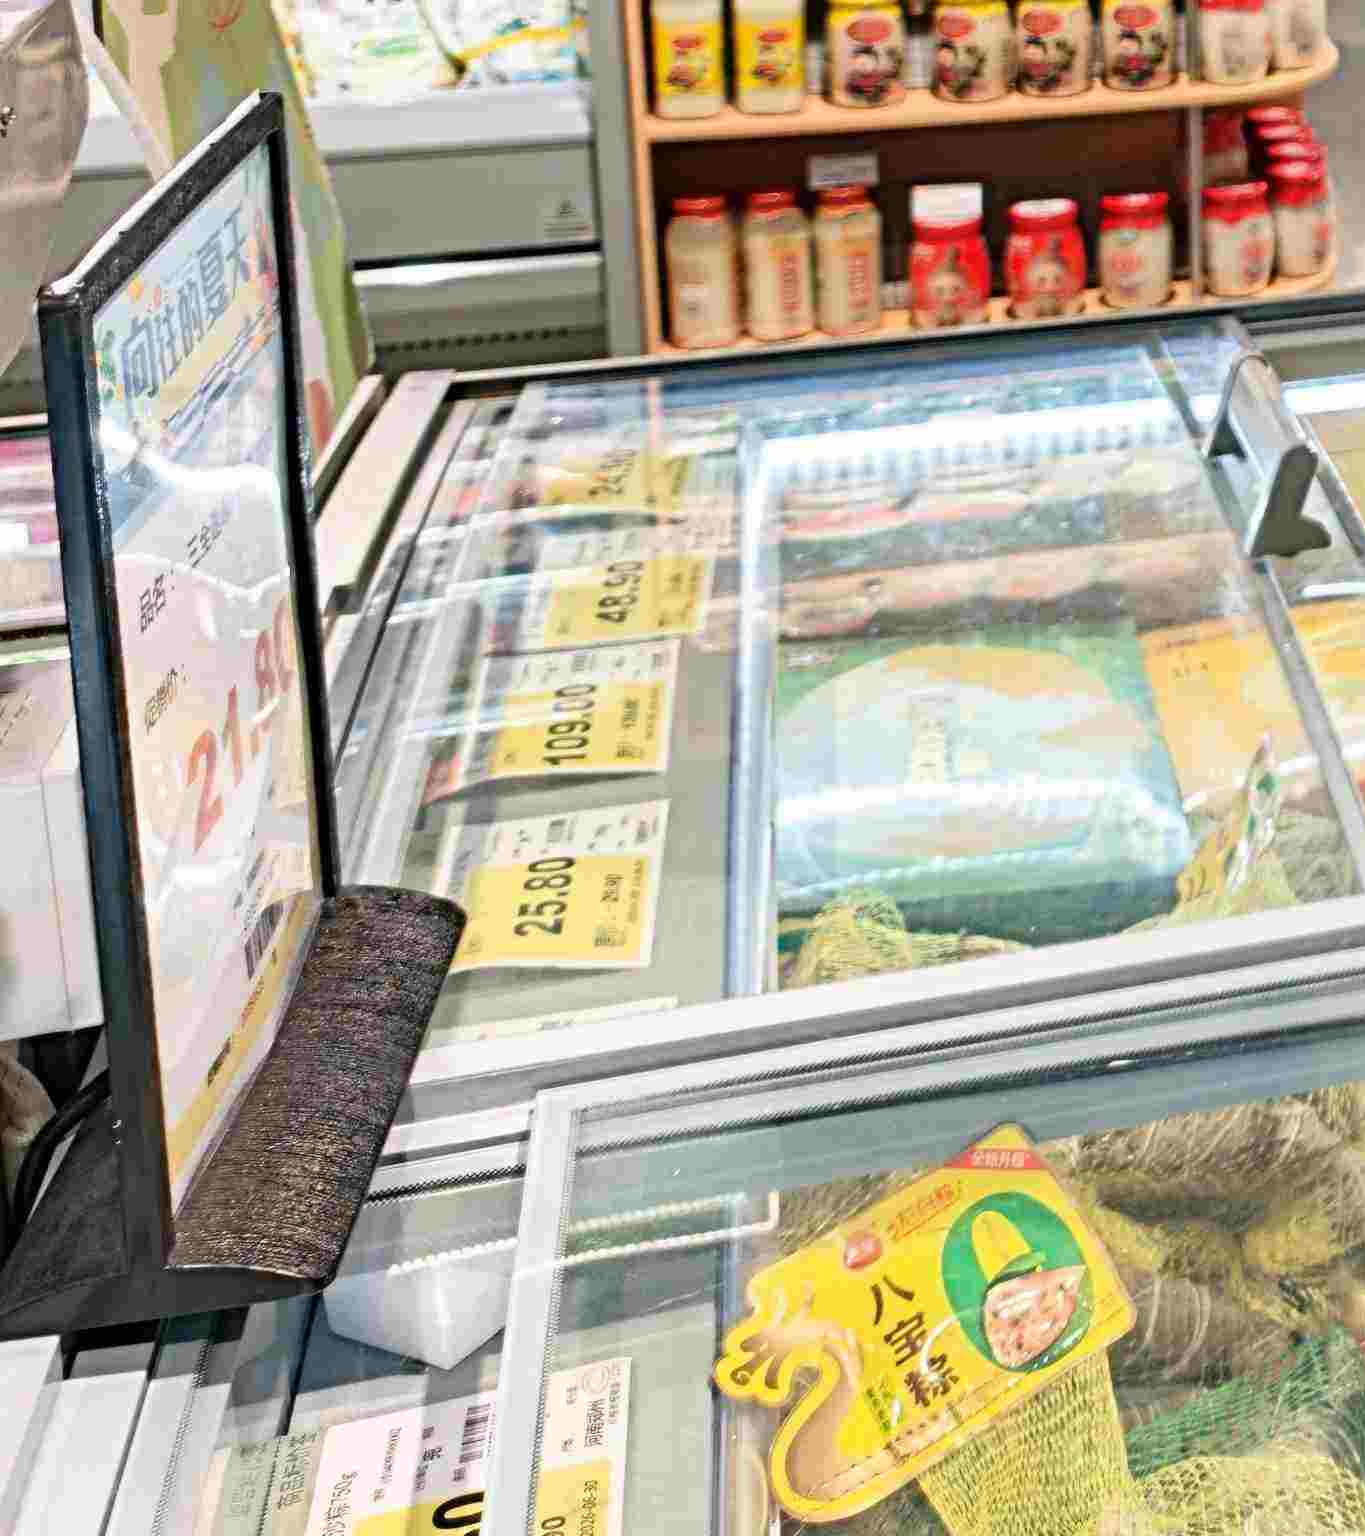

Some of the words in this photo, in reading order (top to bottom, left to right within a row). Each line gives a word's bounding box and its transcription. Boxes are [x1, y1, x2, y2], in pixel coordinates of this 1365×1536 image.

[542, 683, 597, 766] 109.00
[513, 856, 575, 937] 25.80
[870, 1274, 960, 1407] 八宝粽
